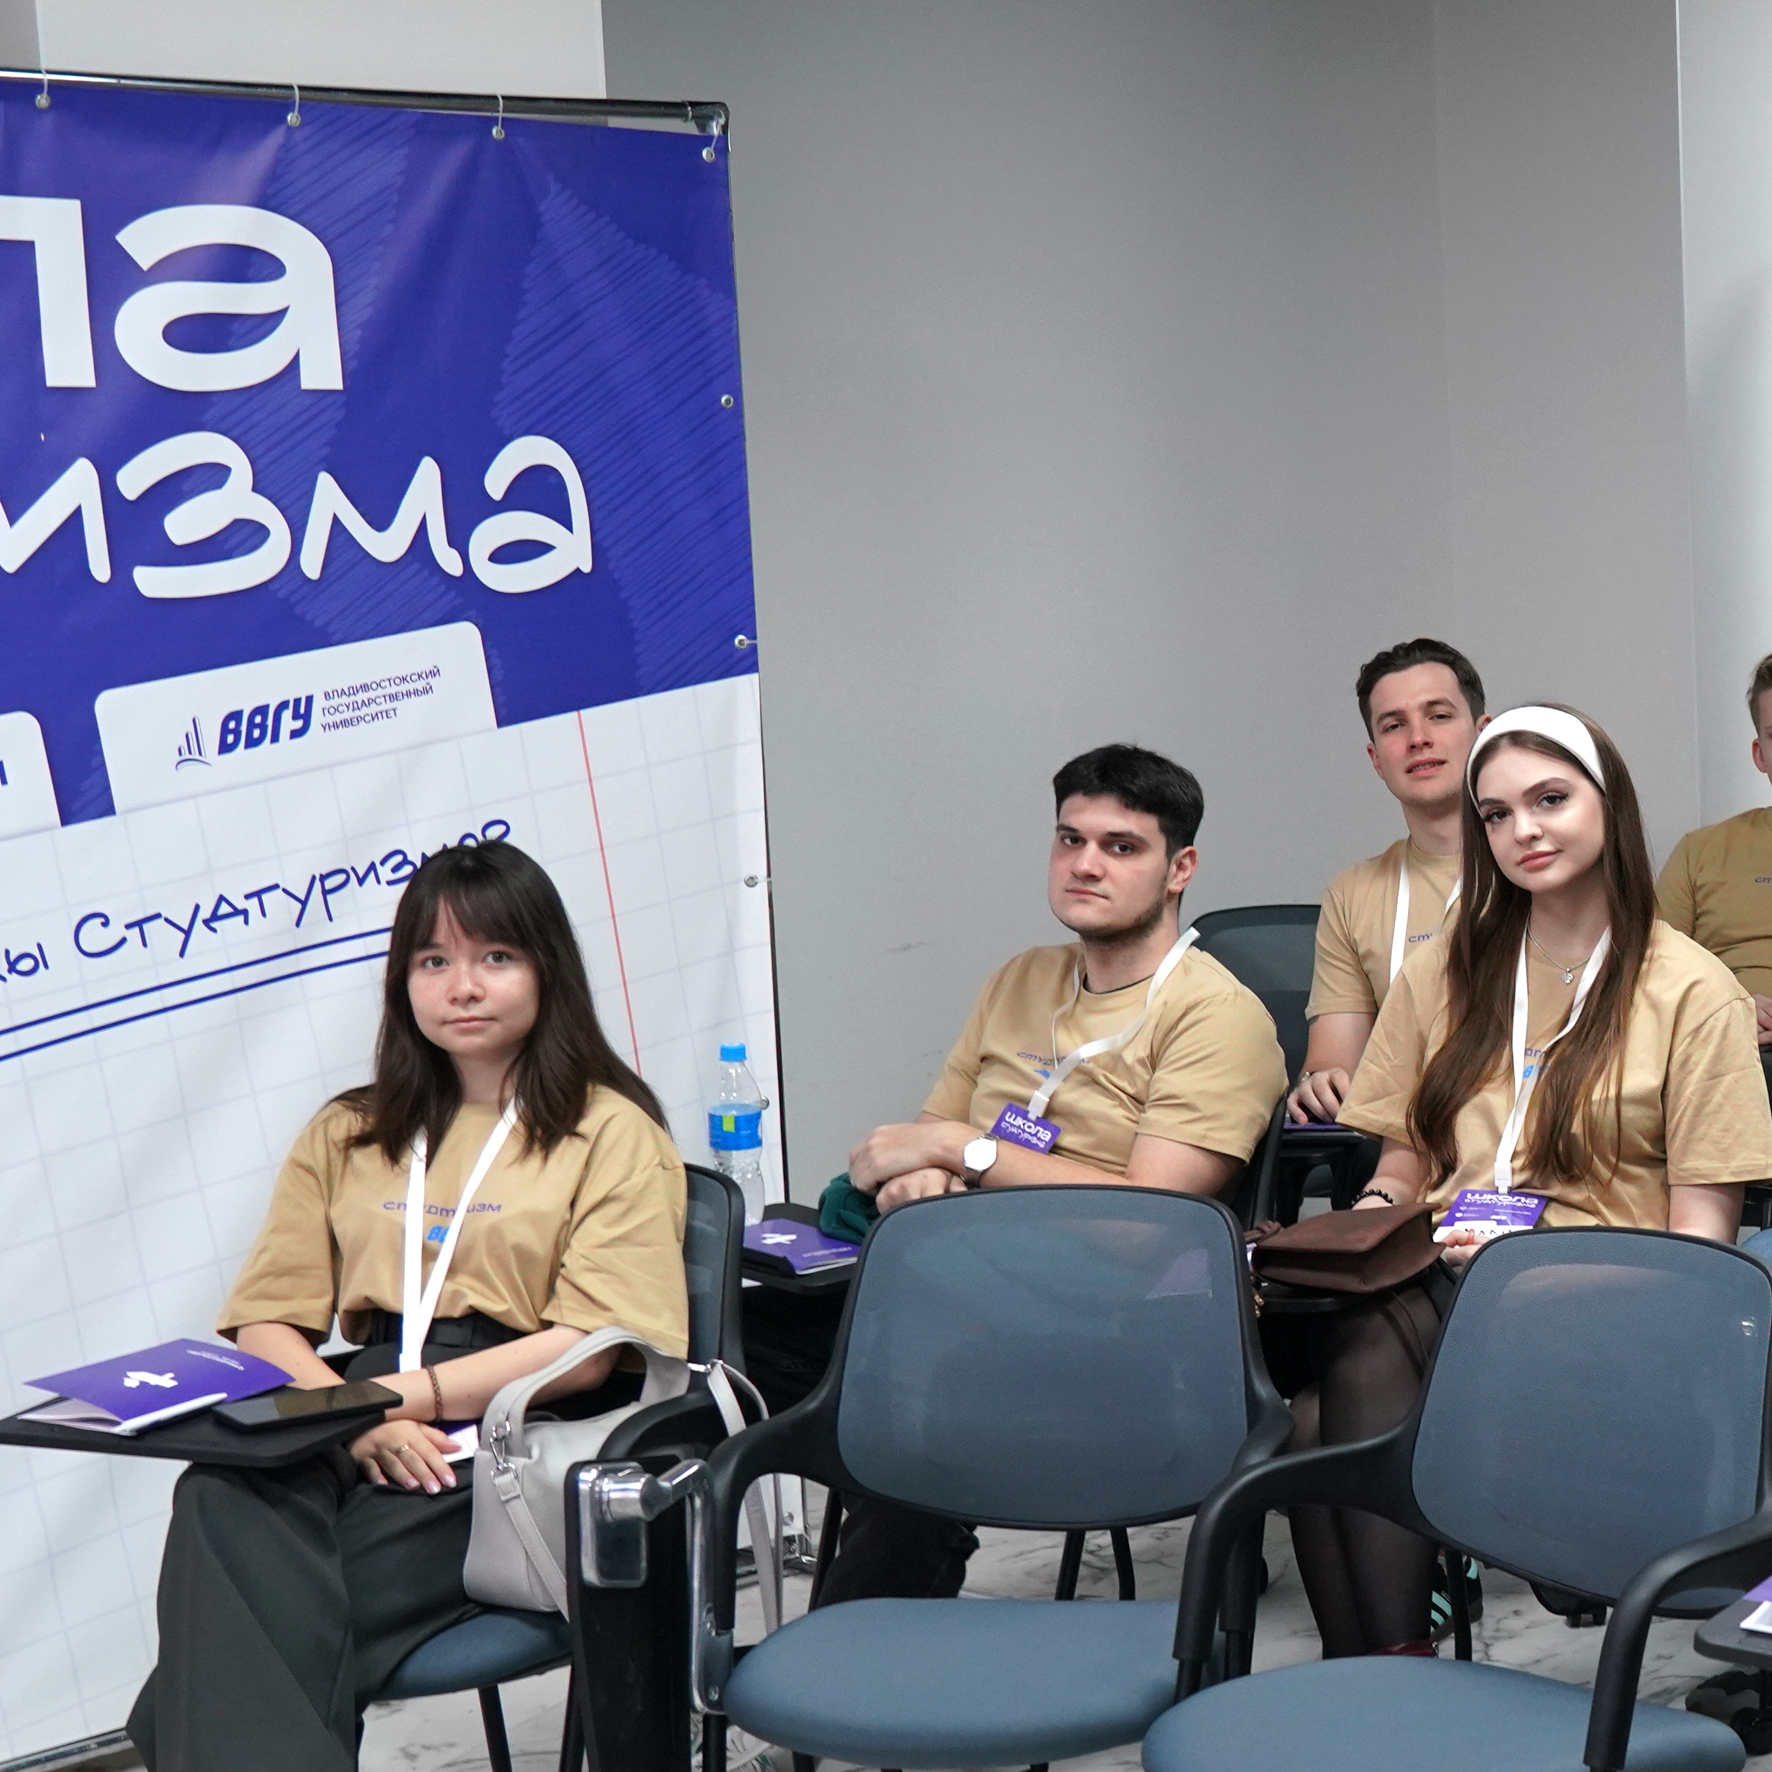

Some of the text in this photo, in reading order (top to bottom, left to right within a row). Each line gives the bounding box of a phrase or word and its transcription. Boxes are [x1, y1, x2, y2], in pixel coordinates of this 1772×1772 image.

[321, 682, 434, 718] ГОСУДАРСТВЕННЫЙ
[323, 665, 442, 702] ВЛАДИВОСТОКСКИЙ
[217, 694, 315, 757] ВВГУ
[320, 707, 399, 734] УНИВЕРСИТЕТ
[0, 819, 511, 983] ы Студтуриз
[1004, 1111, 1052, 1142] школа
